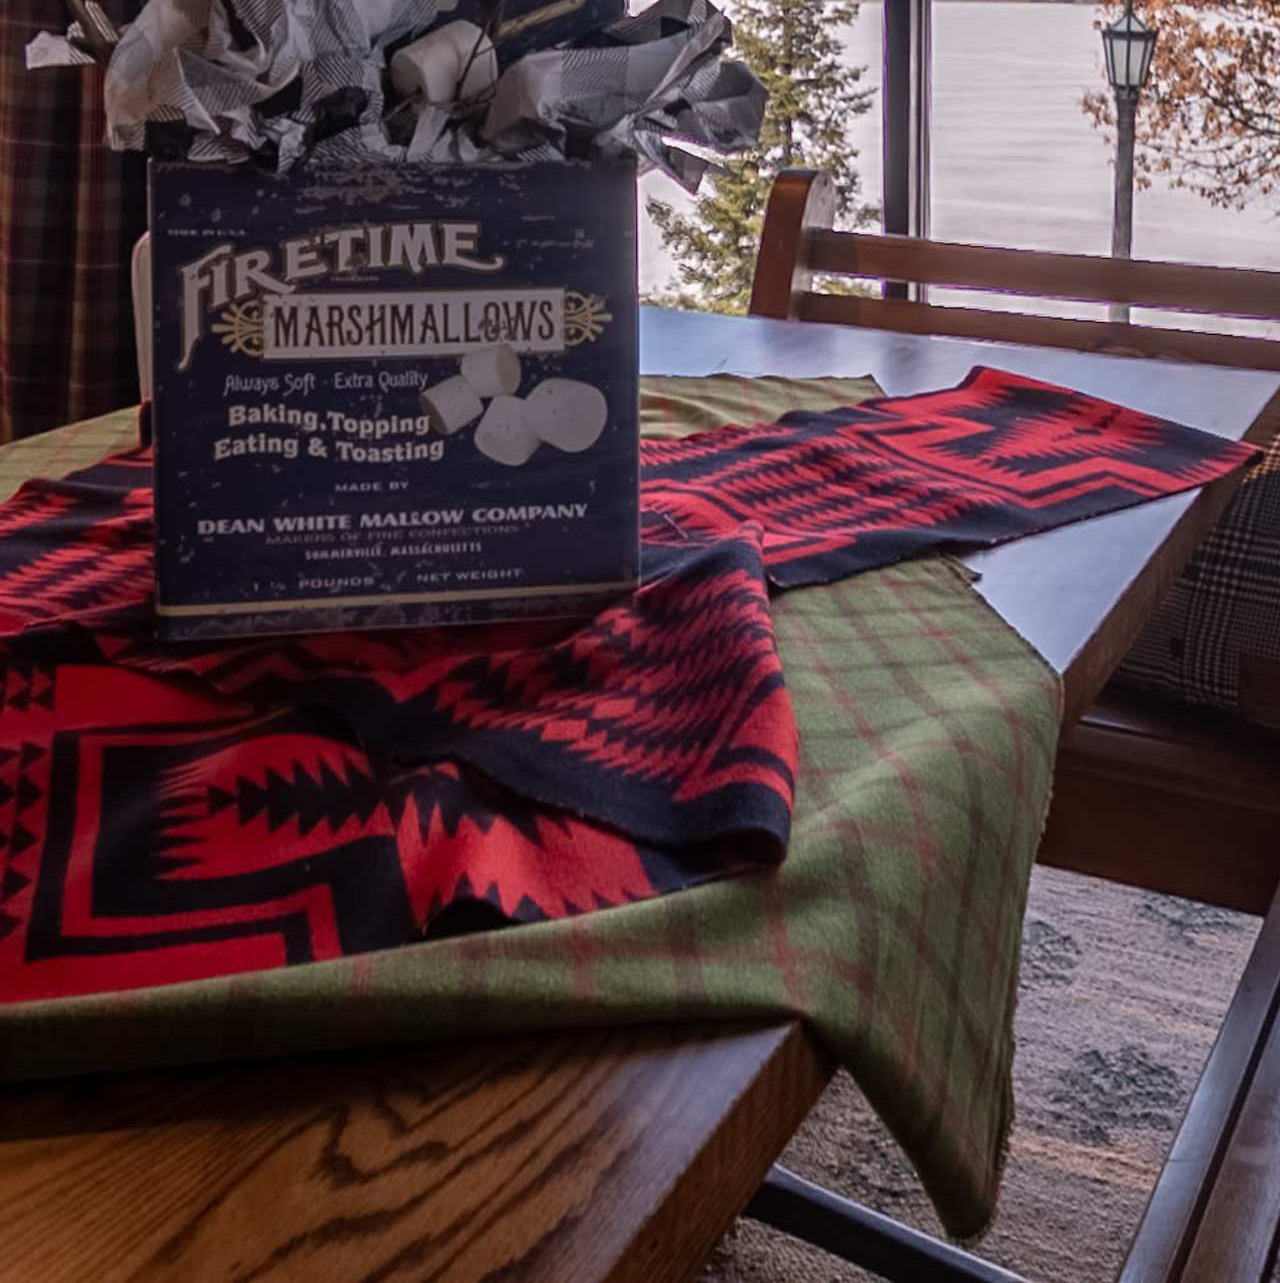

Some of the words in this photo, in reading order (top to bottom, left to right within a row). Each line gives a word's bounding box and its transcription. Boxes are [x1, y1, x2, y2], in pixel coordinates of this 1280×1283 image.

[177, 222, 504, 372] FIRETIME
[272, 299, 556, 348] MARSHMALLOWS
[223, 373, 280, 397] Always
[283, 372, 316, 397] Soft
[334, 371, 374, 390] Extra
[378, 370, 429, 392] Quality
[328, 411, 430, 439] Topping
[214, 435, 299, 460] Eating
[308, 437, 328, 458] &
[335, 439, 445, 464] Toasting
[335, 482, 382, 492] MADE
[389, 481, 410, 491] BY
[197, 517, 266, 535] DEAN
[274, 513, 352, 532] WHITE
[360, 508, 465, 529] MALLOW
[472, 503, 588, 522] COMPANY
[298, 577, 375, 590] POUNDS
[416, 571, 451, 583] NET
[455, 568, 525, 581] WEIGHT
